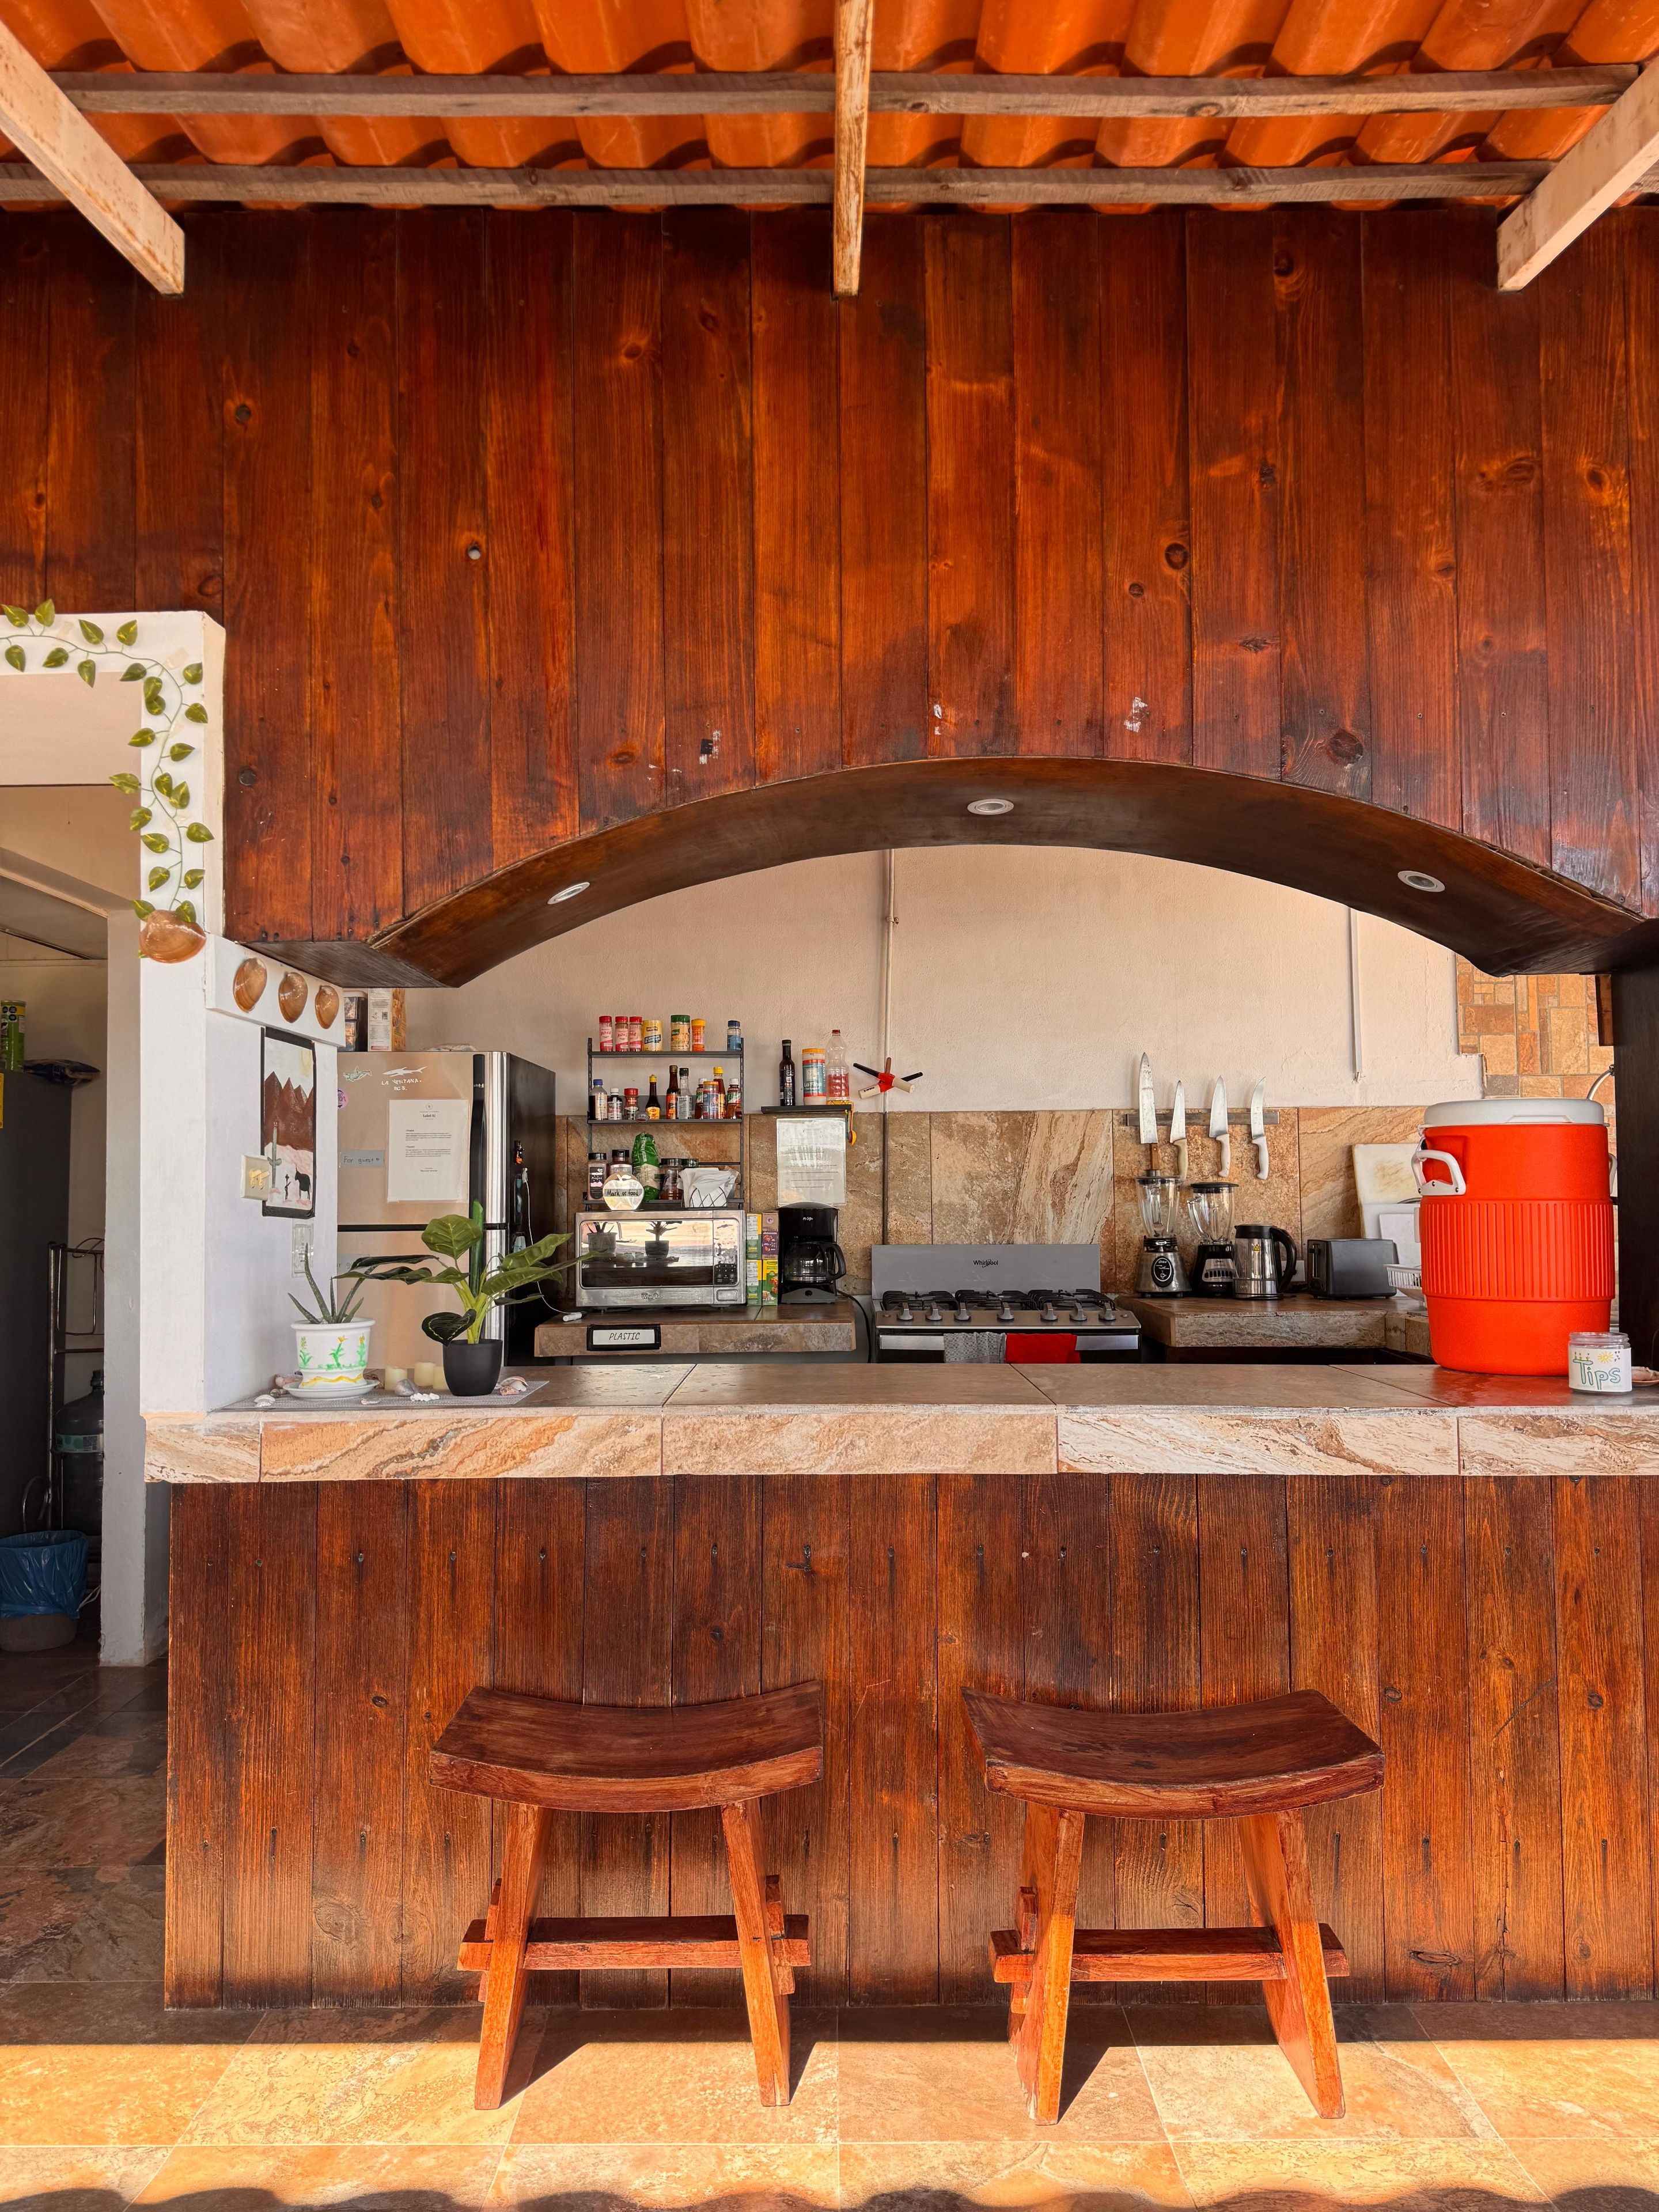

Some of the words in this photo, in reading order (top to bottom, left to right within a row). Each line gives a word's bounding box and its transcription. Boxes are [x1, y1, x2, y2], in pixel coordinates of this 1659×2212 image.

[607, 1189, 620, 1197] Mark
[973, 1259, 998, 1268] Whirlpool
[609, 1332, 640, 1340] PLASTIC
[1573, 1358, 1621, 1390] Tips
